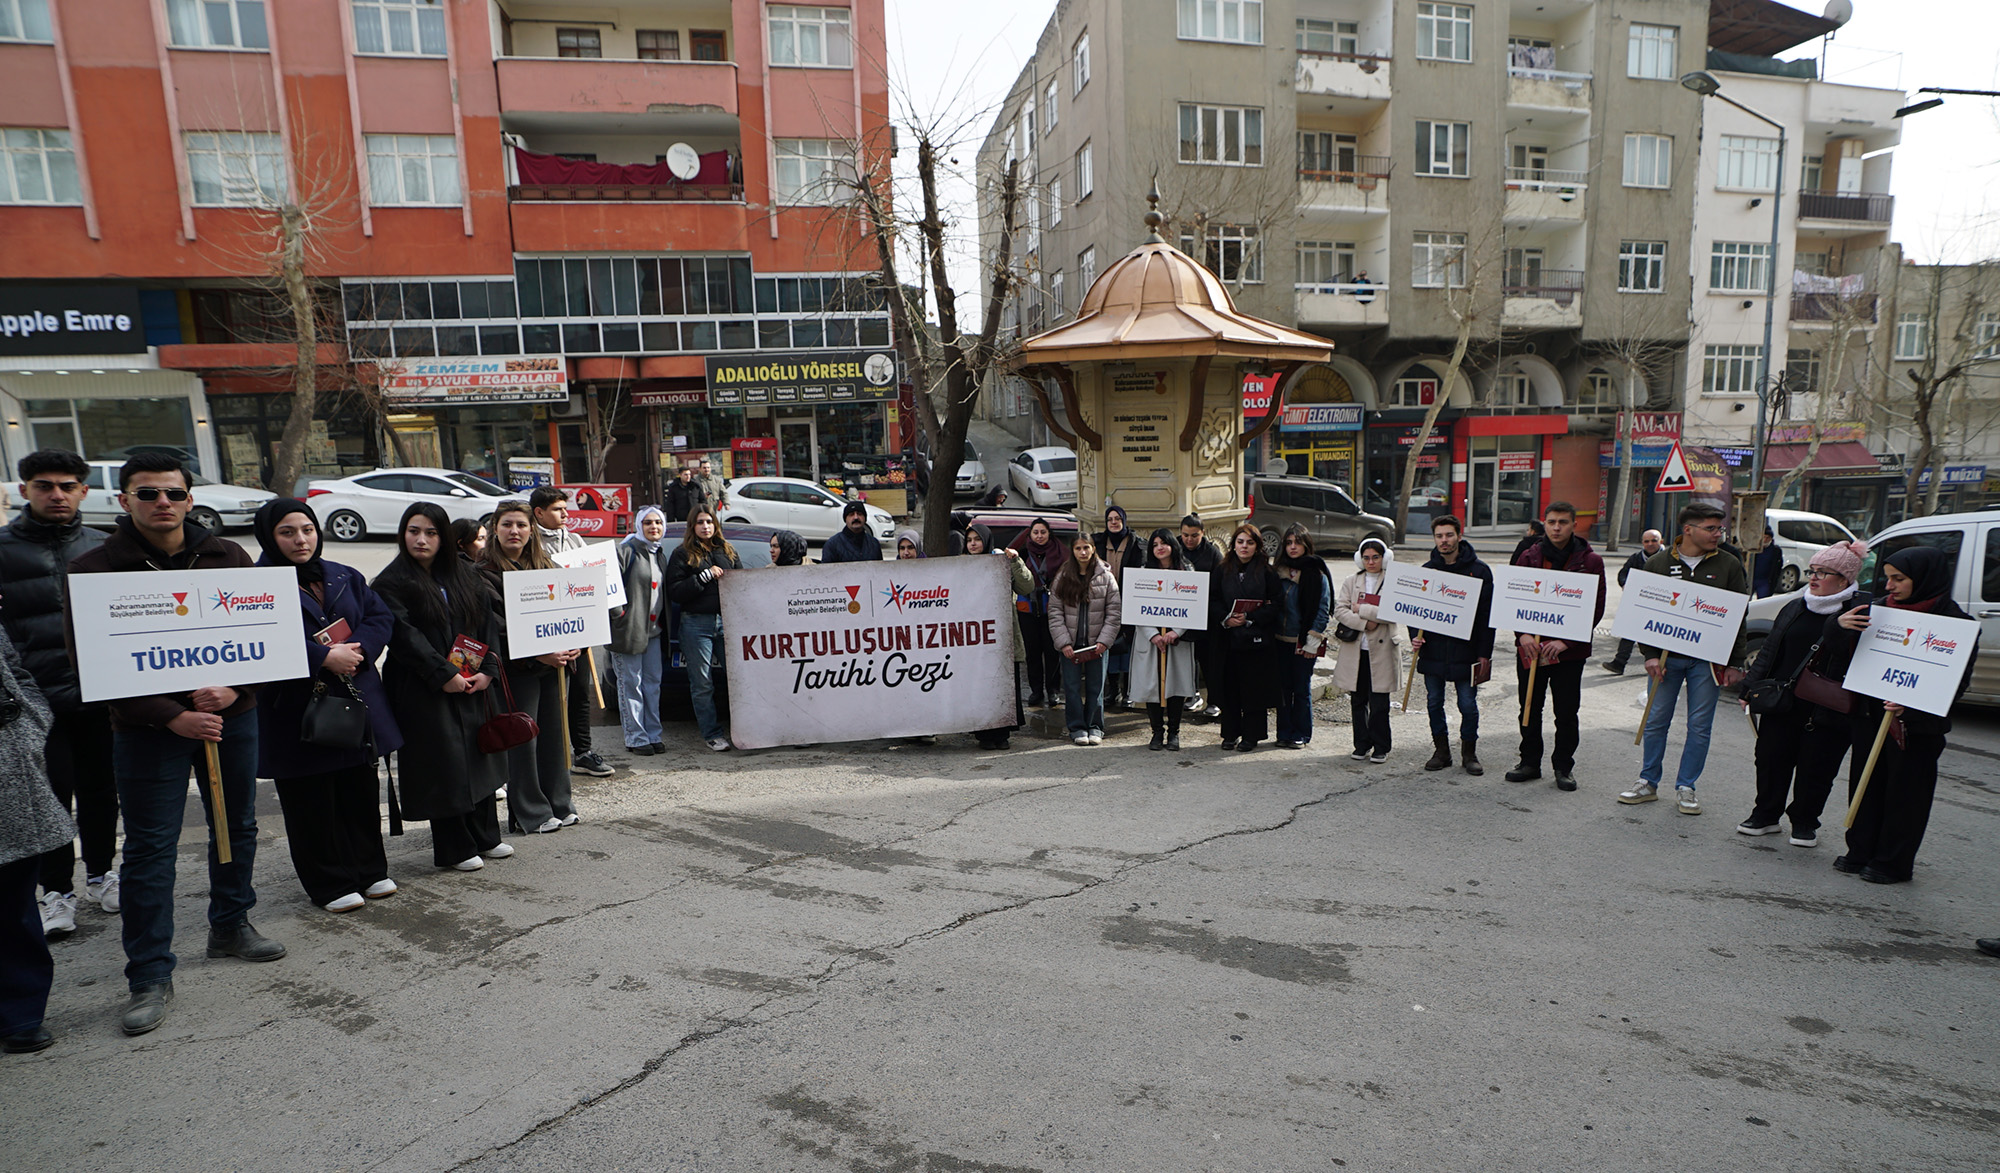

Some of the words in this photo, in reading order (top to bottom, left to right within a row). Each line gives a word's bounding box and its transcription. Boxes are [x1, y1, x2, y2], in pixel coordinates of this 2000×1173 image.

[64, 309, 132, 332] Emre
[415, 363, 499, 375] ZEMZEM
[715, 363, 798, 384] ADALIOĞLU
[801, 361, 863, 380] YÖRESEL
[406, 377, 422, 388] ve
[426, 375, 471, 387] TAVUK
[478, 373, 557, 386] IZGARALARI
[641, 393, 700, 405] ADALIOĞLU
[740, 440, 763, 448] Coca-Cola
[573, 584, 595, 594] pusula
[902, 585, 950, 605] pusula
[1559, 587, 1583, 595] pusula
[109, 602, 174, 611] Kahramanmaraş
[230, 592, 275, 609] pusula
[788, 597, 847, 606] Kahramanmaraş
[908, 597, 950, 610] maraş
[110, 609, 144, 618] Büyükşehir
[145, 608, 175, 616] Belediyesi
[236, 602, 275, 612] maraş
[788, 606, 819, 616] Büyükşehir
[820, 604, 847, 614] Belediyesi
[1140, 605, 1189, 618] PAZARCIK
[1699, 603, 1728, 614] pusula
[1516, 608, 1565, 625] NURHAK
[1643, 619, 1702, 643] ANDIRIN
[742, 625, 911, 660] KURTULUŞUN
[1931, 637, 1958, 649] pusula
[131, 640, 266, 672] TÜRKOĞLU
[791, 657, 876, 694] Tarihi
[882, 652, 953, 693] Gezi
